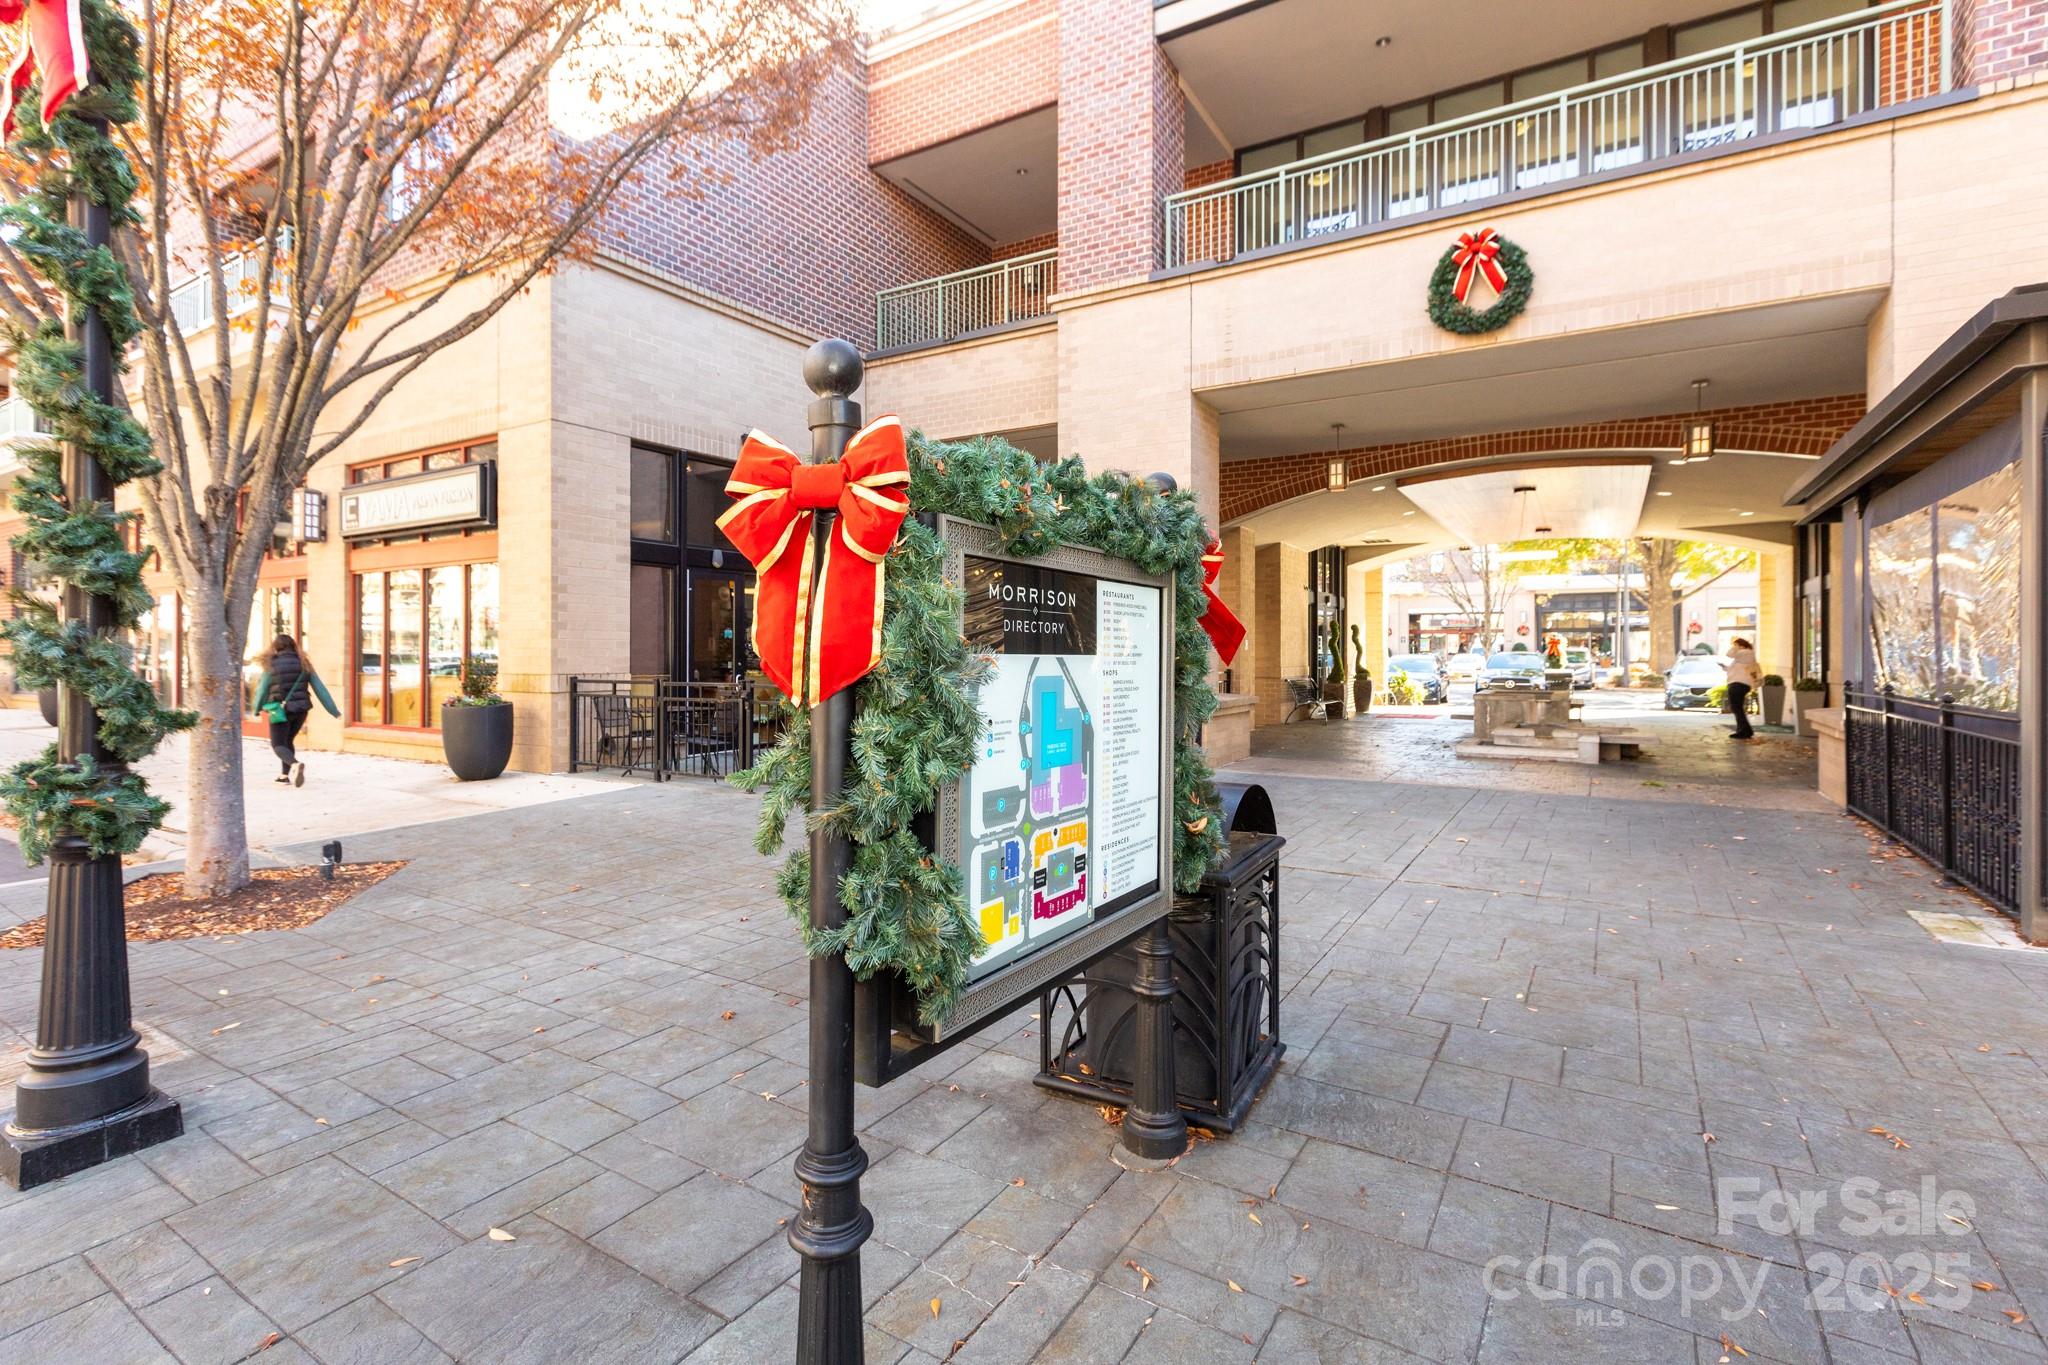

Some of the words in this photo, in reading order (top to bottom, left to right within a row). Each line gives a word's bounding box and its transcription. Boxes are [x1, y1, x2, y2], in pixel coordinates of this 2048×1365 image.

[989, 584, 1076, 607] MORRISON
[1102, 590, 1135, 600] RESTAURANTS
[1003, 619, 1064, 634] DIRECTORY
[1101, 836, 1129, 851] RESIDENCES
